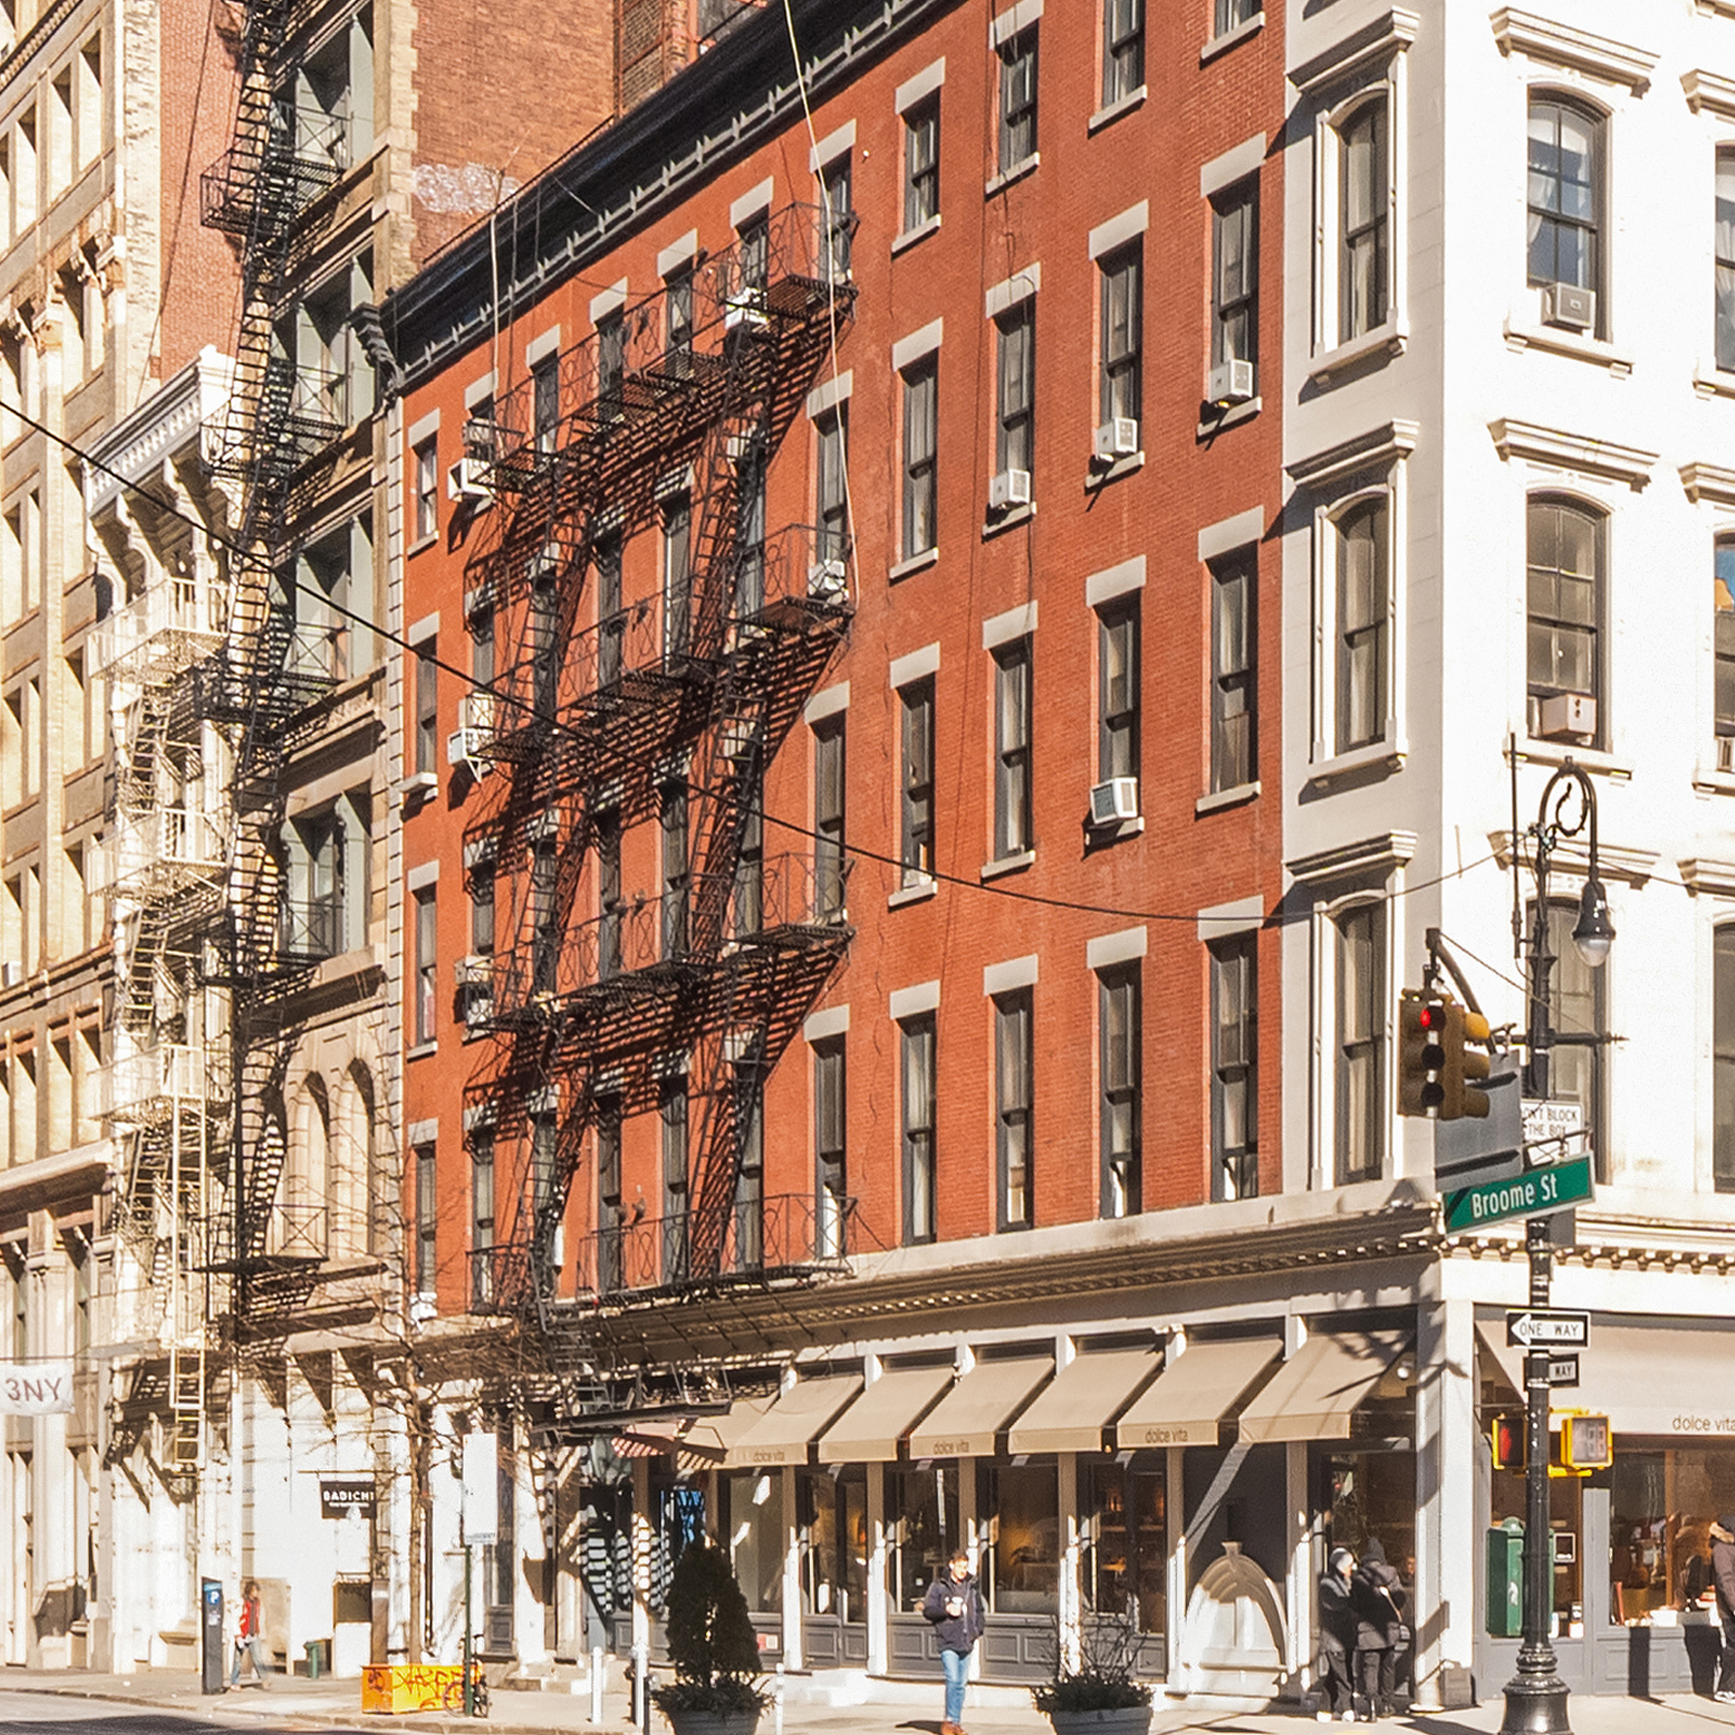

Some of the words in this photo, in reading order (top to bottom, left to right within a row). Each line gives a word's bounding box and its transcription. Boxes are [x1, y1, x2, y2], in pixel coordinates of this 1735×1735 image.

[1547, 1106, 1578, 1122] BLOCK
[1528, 1123, 1545, 1136] THE
[1471, 1182, 1536, 1219] Broome
[1540, 1173, 1558, 1202] St
[1519, 1322, 1543, 1337] ONE
[1554, 1323, 1580, 1337] WAY
[1555, 1364, 1573, 1378] WAY
[5, 1376, 63, 1403] 3NY
[1672, 1415, 1711, 1432] dolce
